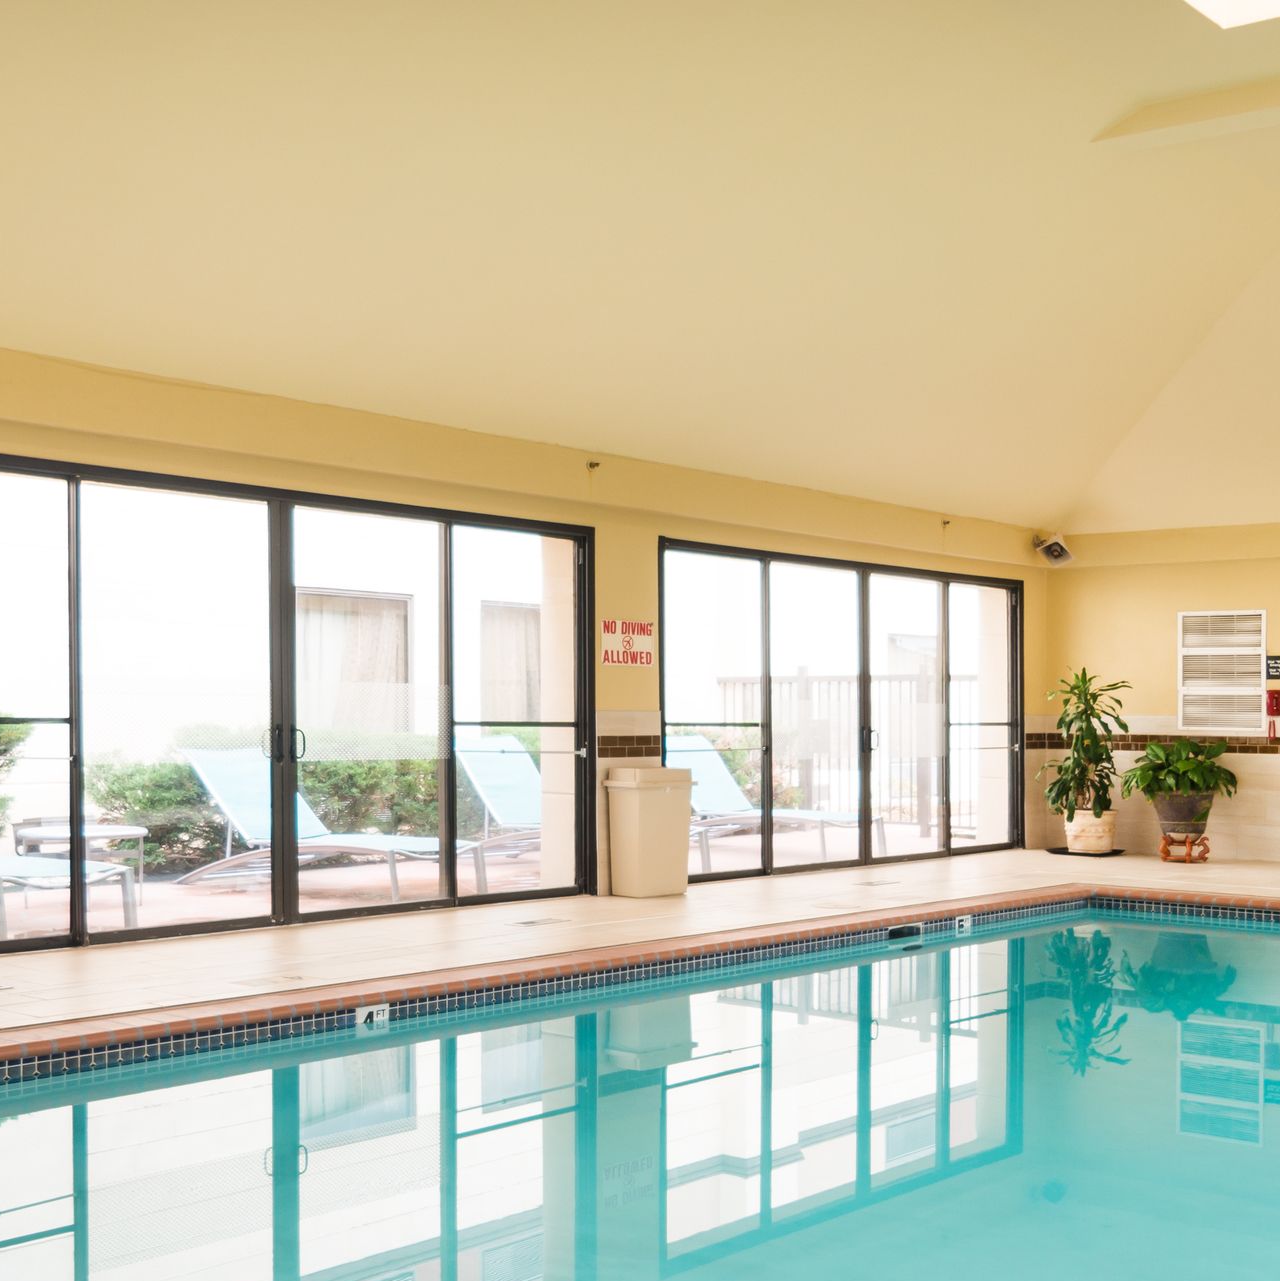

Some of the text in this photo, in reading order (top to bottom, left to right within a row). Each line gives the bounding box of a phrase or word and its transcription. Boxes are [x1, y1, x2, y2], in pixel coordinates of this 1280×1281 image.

[603, 620, 652, 637] NO DIVING
[602, 649, 653, 666] ALLOWED
[376, 1009, 386, 1018] FT
